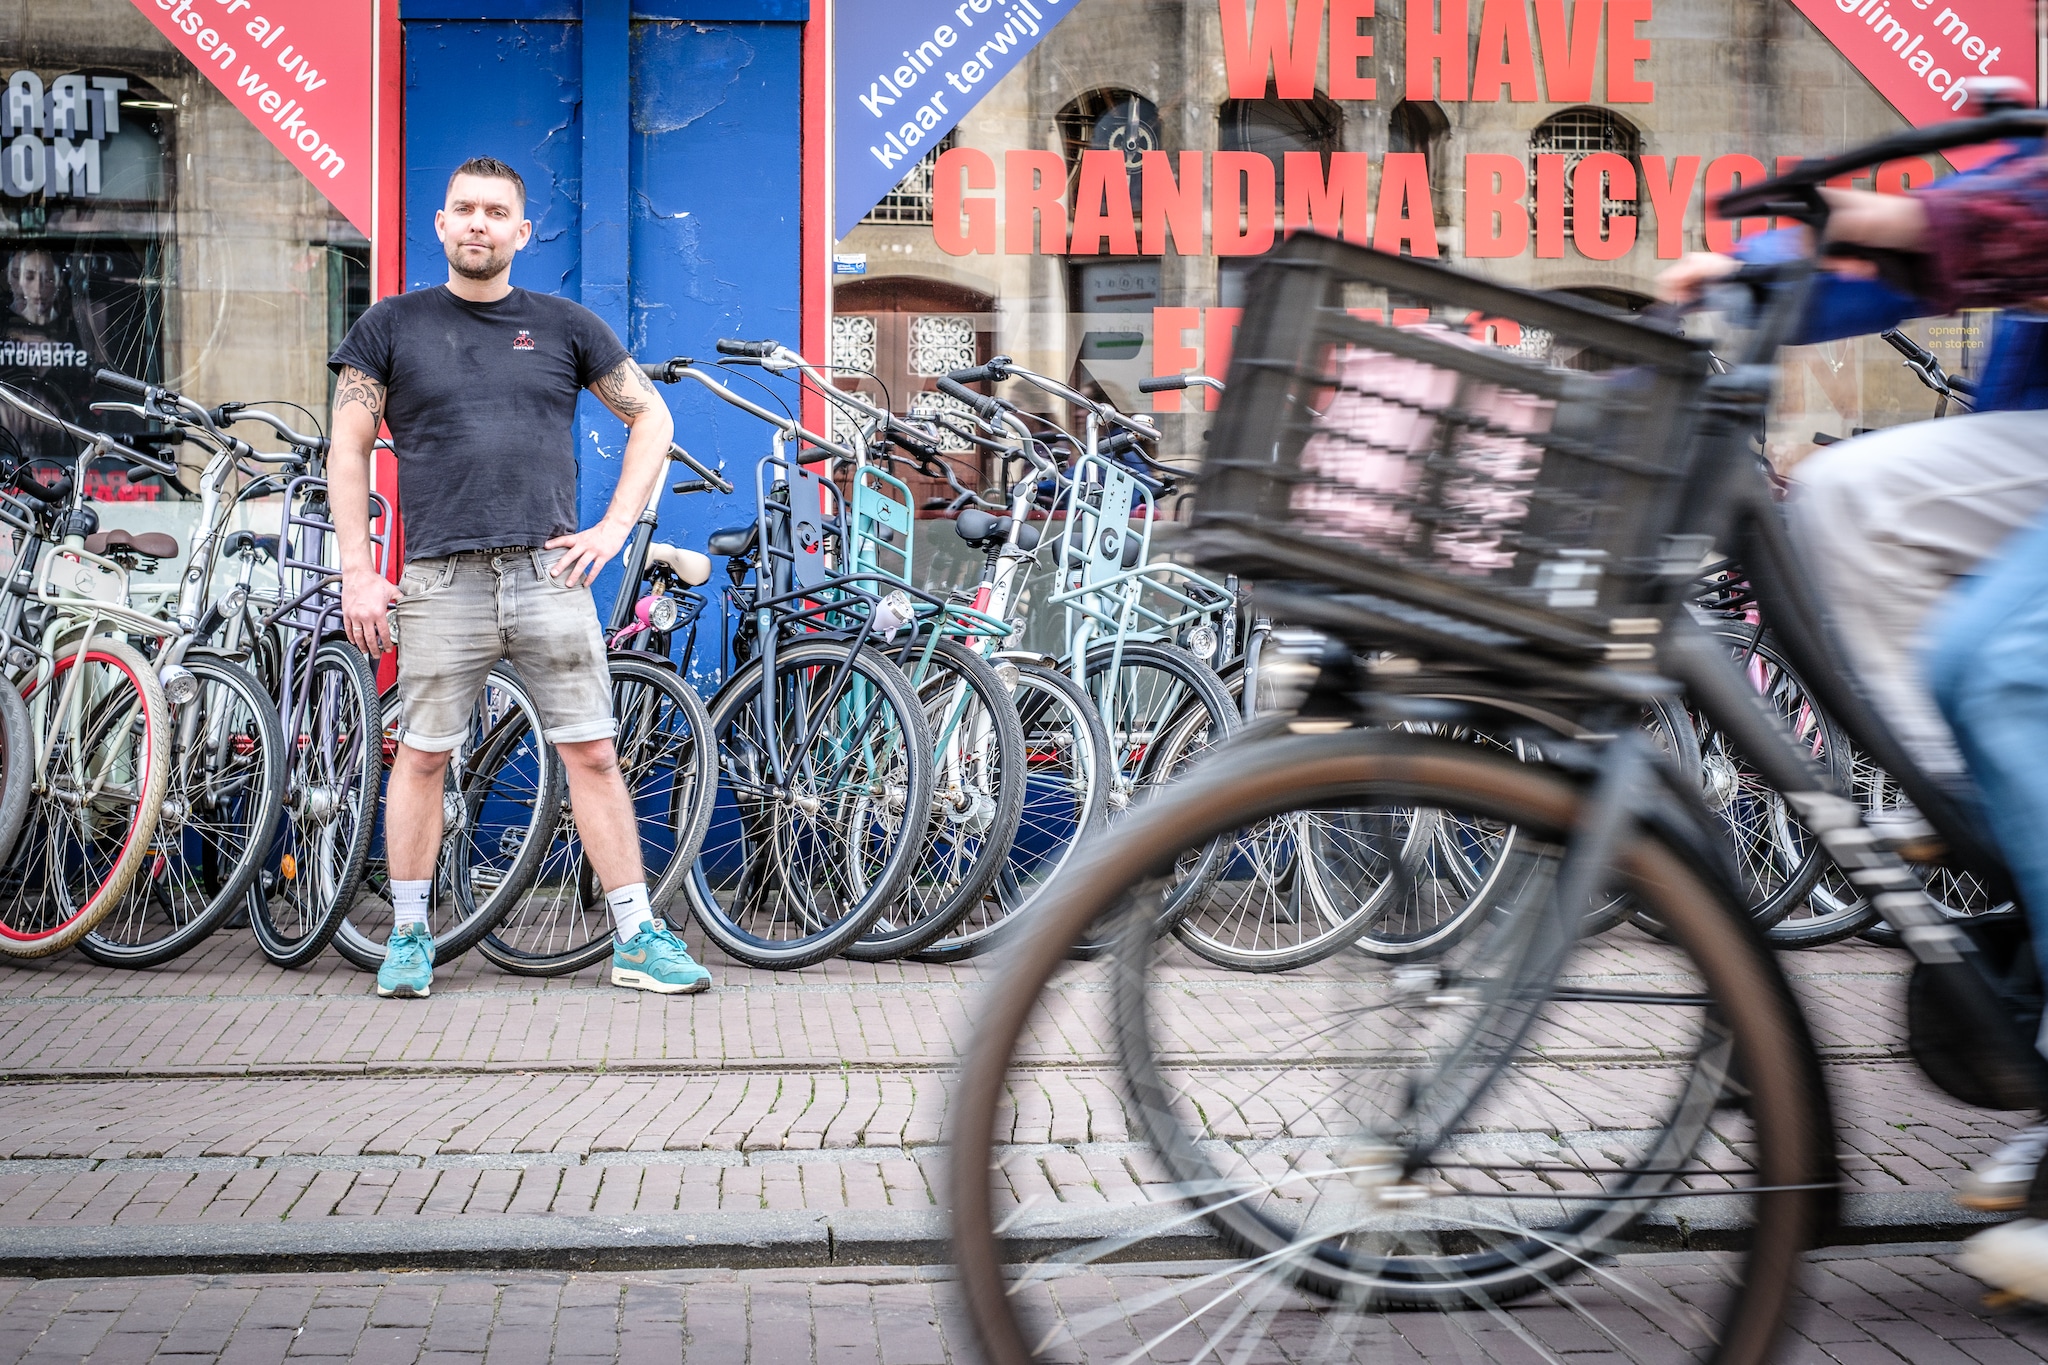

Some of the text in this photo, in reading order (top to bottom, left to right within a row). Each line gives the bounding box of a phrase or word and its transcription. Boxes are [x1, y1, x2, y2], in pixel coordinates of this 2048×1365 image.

[246, 15, 285, 49] al
[277, 45, 327, 92] uw
[858, 0, 1006, 119] Kleine re
[869, 0, 1043, 170] klaar terwijl
[1220, 0, 1654, 103] WE HAVE
[1933, 7, 2001, 75] met
[236, 65, 346, 179] welkom
[932, 147, 1935, 261] GRANDMA BICYC
[1928, 327, 1980, 337] opnemen
[1928, 339, 1984, 349] en storten
